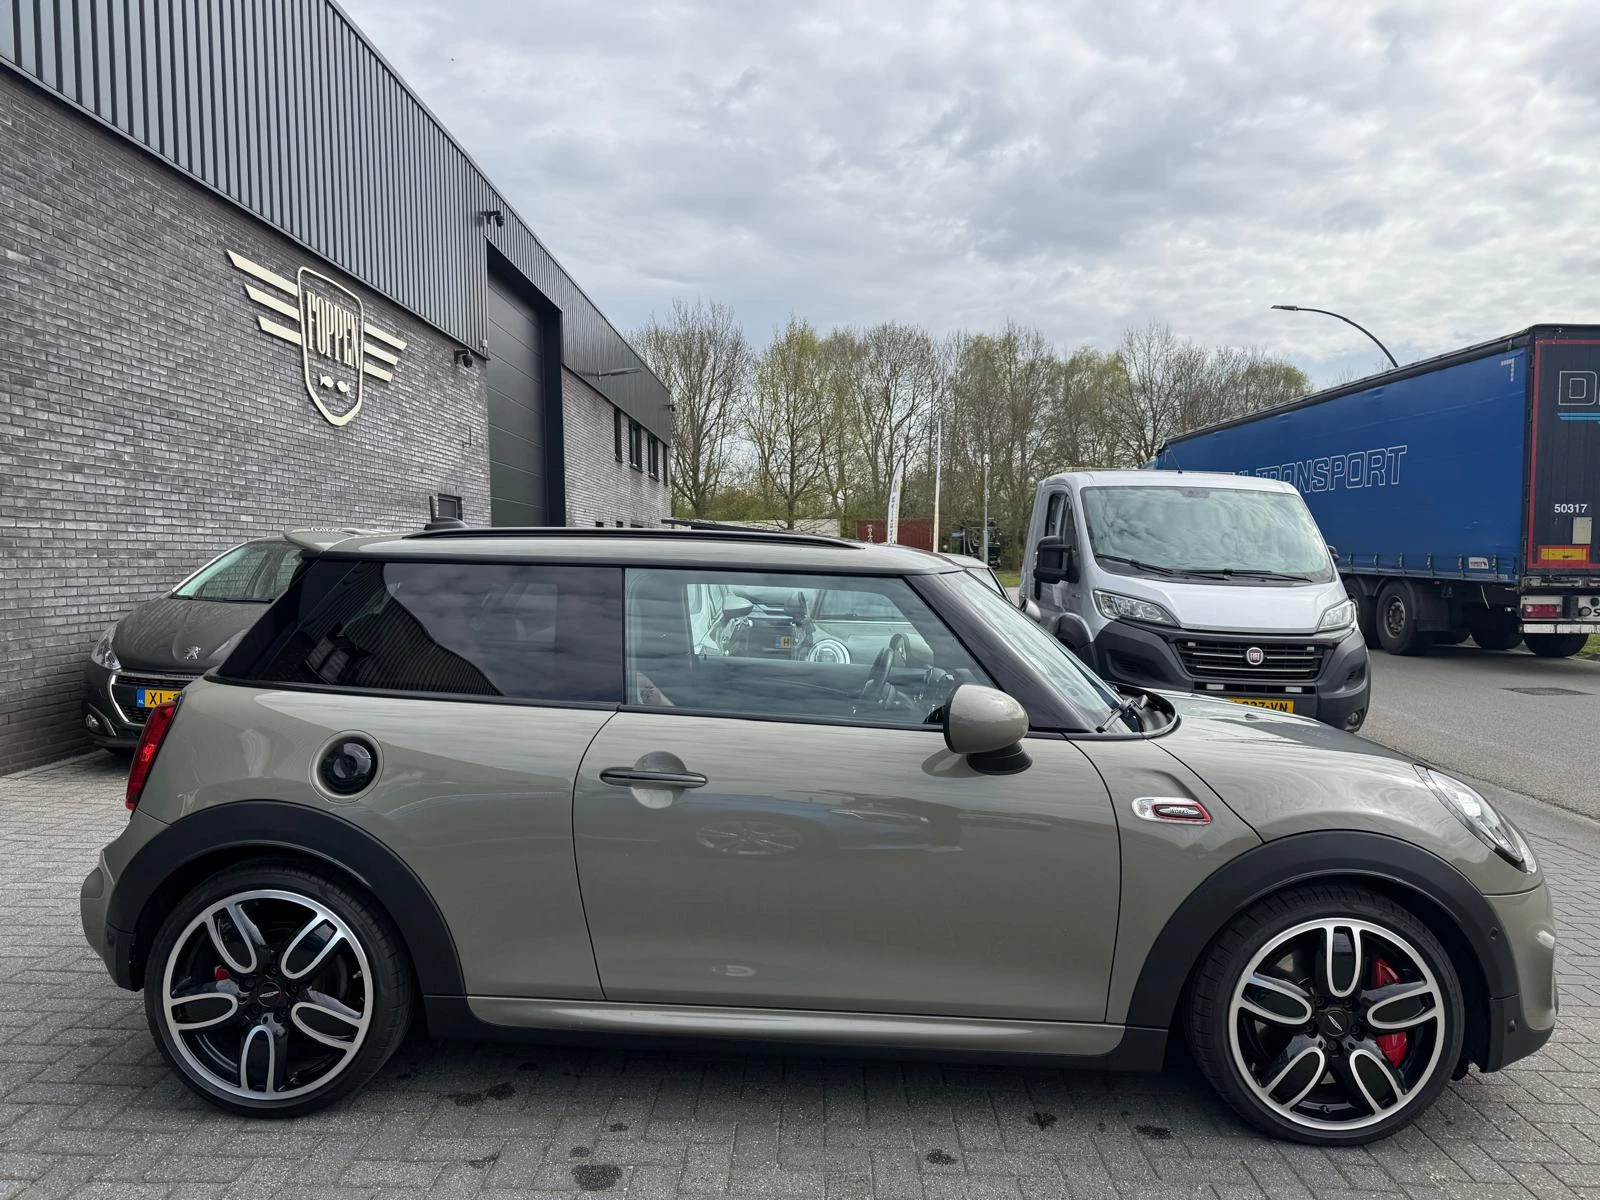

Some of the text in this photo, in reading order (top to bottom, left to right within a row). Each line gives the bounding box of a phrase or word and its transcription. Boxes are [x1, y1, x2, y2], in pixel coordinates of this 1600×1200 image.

[306, 290, 359, 369] FOPPEN
[1554, 503, 1588, 513] 50317
[1249, 652, 1260, 661] FIAT
